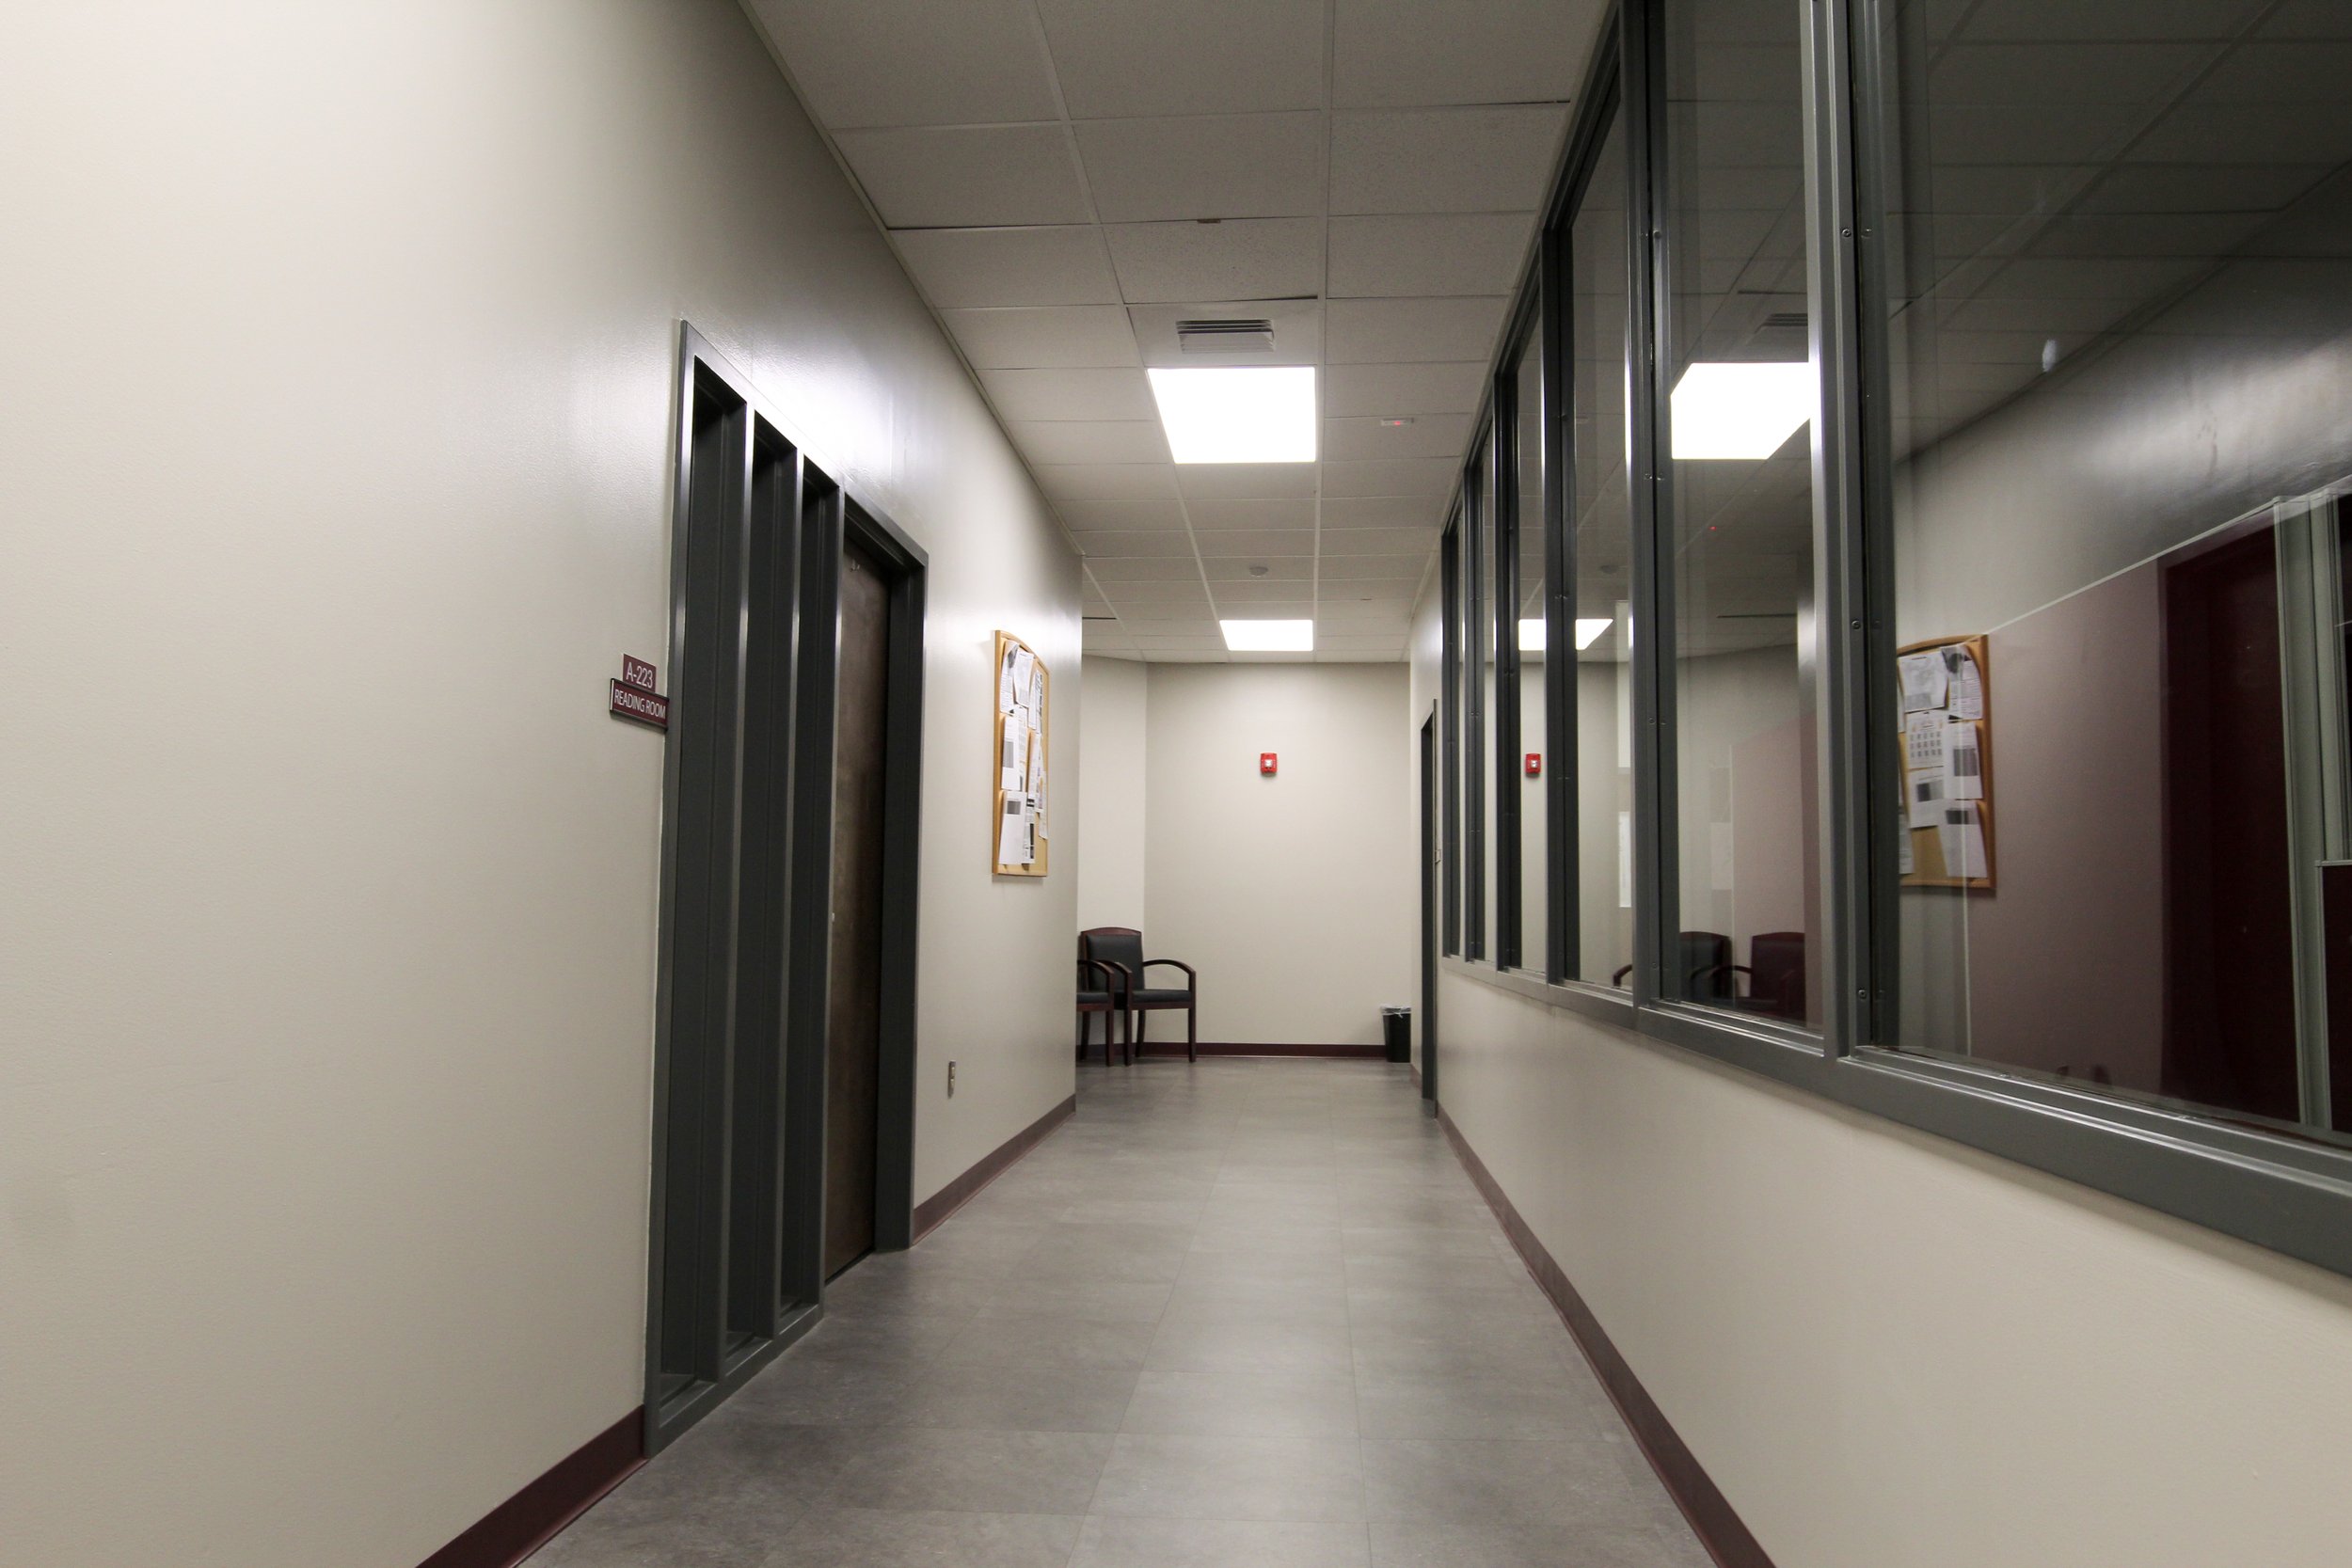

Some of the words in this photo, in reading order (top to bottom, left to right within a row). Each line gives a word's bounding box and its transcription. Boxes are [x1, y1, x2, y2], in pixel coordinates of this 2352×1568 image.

[626, 661, 653, 689] A-223
[613, 689, 645, 712] READING
[645, 699, 666, 719] ROOM
